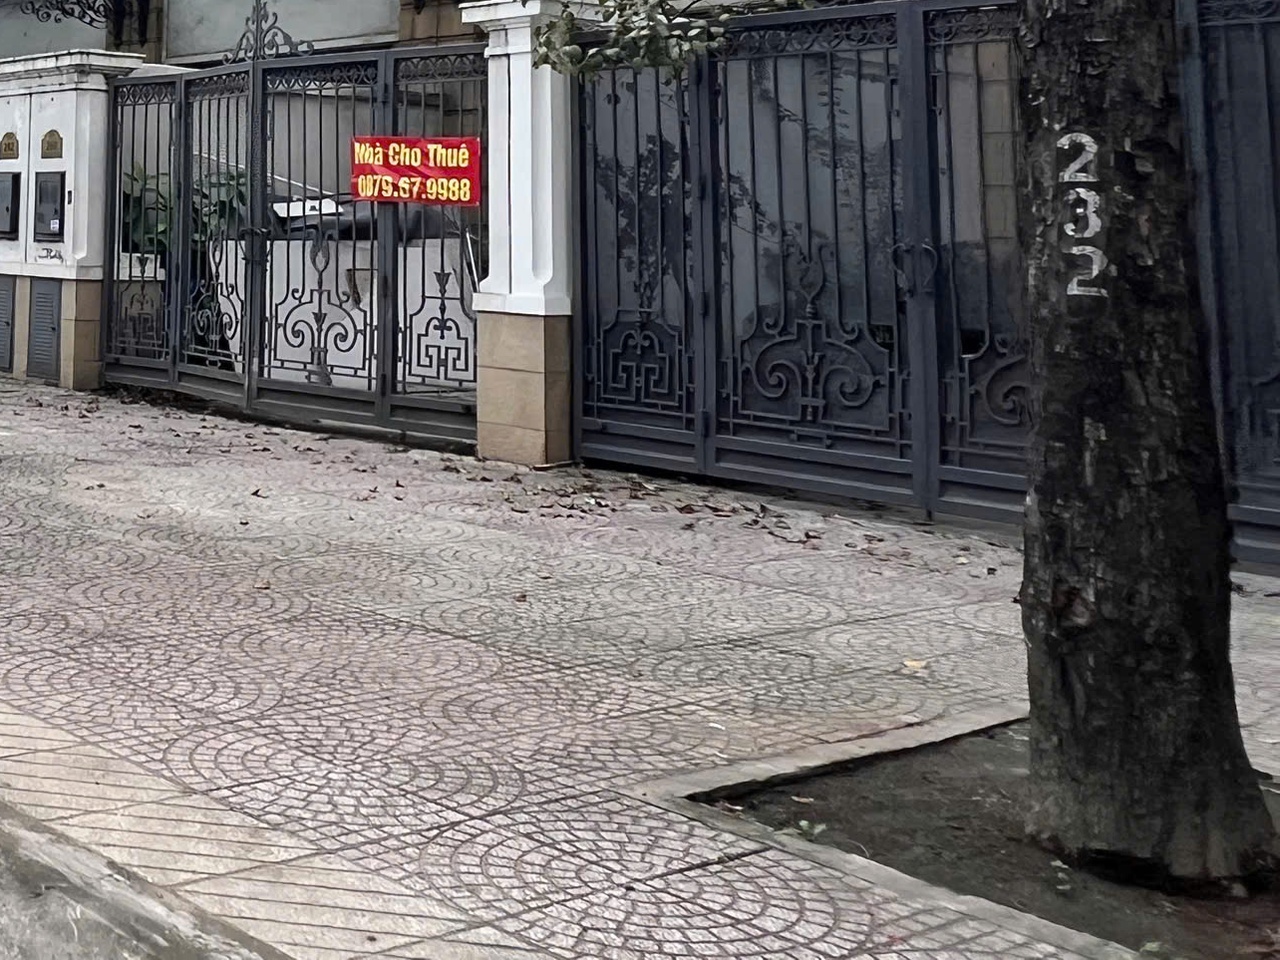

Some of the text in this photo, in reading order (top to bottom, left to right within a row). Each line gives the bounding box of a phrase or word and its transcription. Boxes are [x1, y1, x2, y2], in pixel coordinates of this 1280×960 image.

[355, 142, 469, 168] Nhà Cho Thuê
